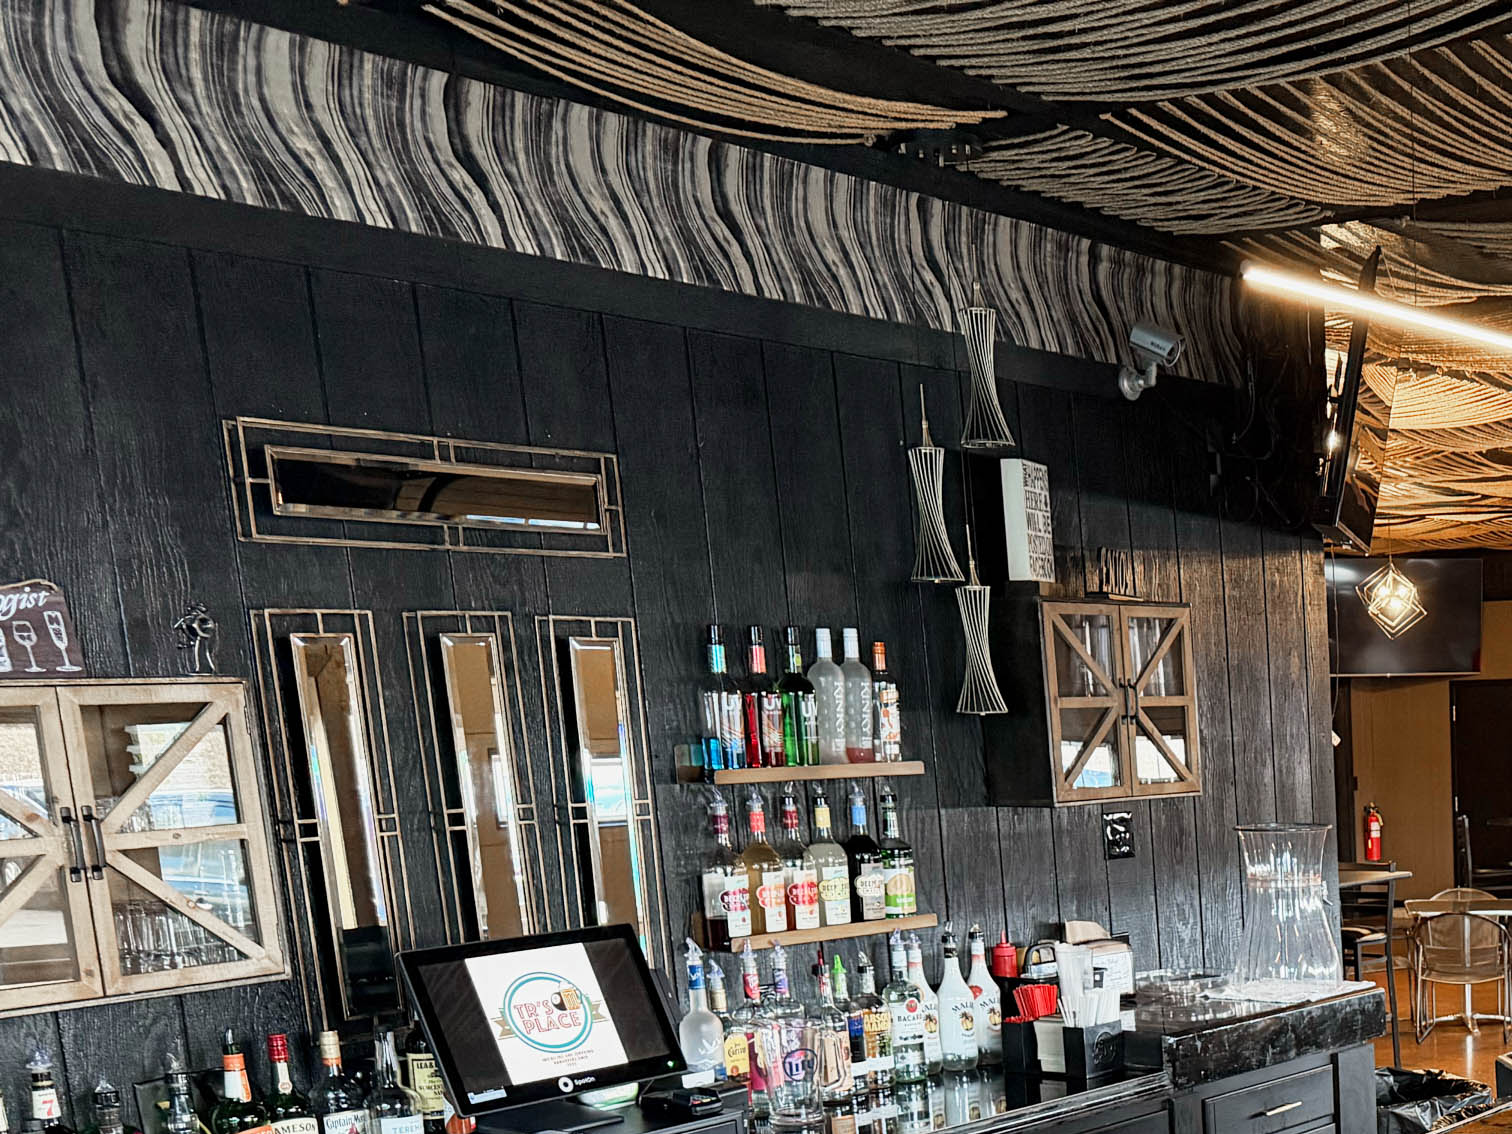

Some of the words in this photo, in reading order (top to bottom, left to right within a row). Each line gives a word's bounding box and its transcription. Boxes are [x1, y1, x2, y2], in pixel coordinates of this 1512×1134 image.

[514, 1000, 554, 1019] TR'S
[523, 1012, 581, 1034] PLACE
[326, 1115, 353, 1130] Captain
